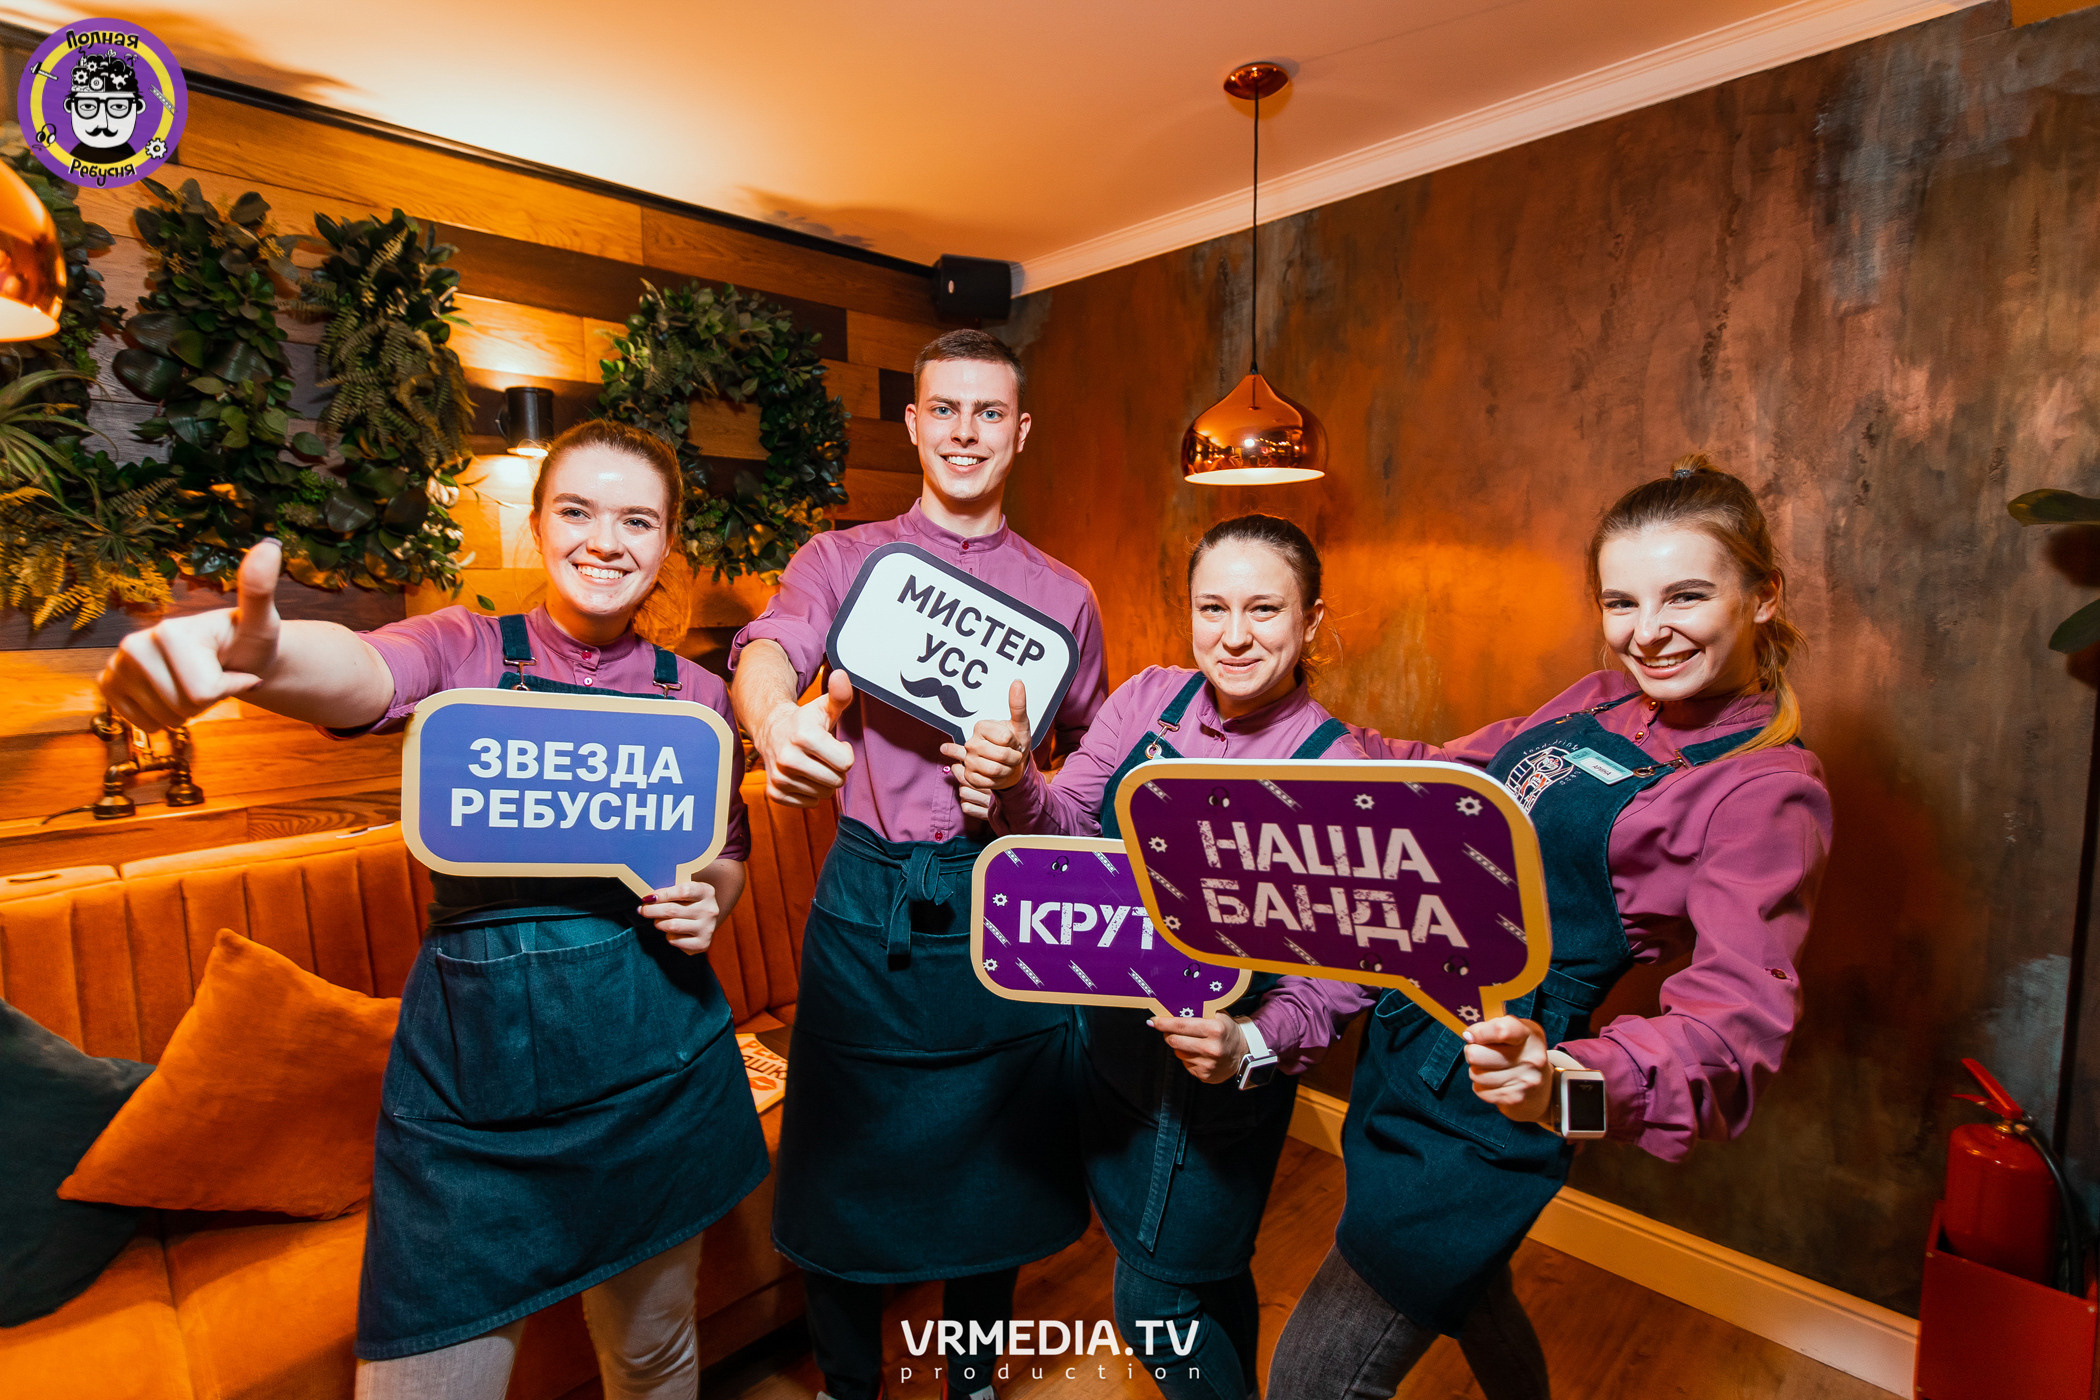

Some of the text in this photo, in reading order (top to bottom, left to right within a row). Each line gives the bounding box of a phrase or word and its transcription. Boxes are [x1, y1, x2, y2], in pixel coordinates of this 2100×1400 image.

[897, 574, 1045, 667] МИСТЕР
[916, 632, 989, 689] УСС
[468, 738, 683, 789] ЗВЕЗДА
[451, 788, 695, 831] РЕБУСНИ
[1197, 820, 1441, 884] НАША
[1200, 878, 1469, 952] БАНДА
